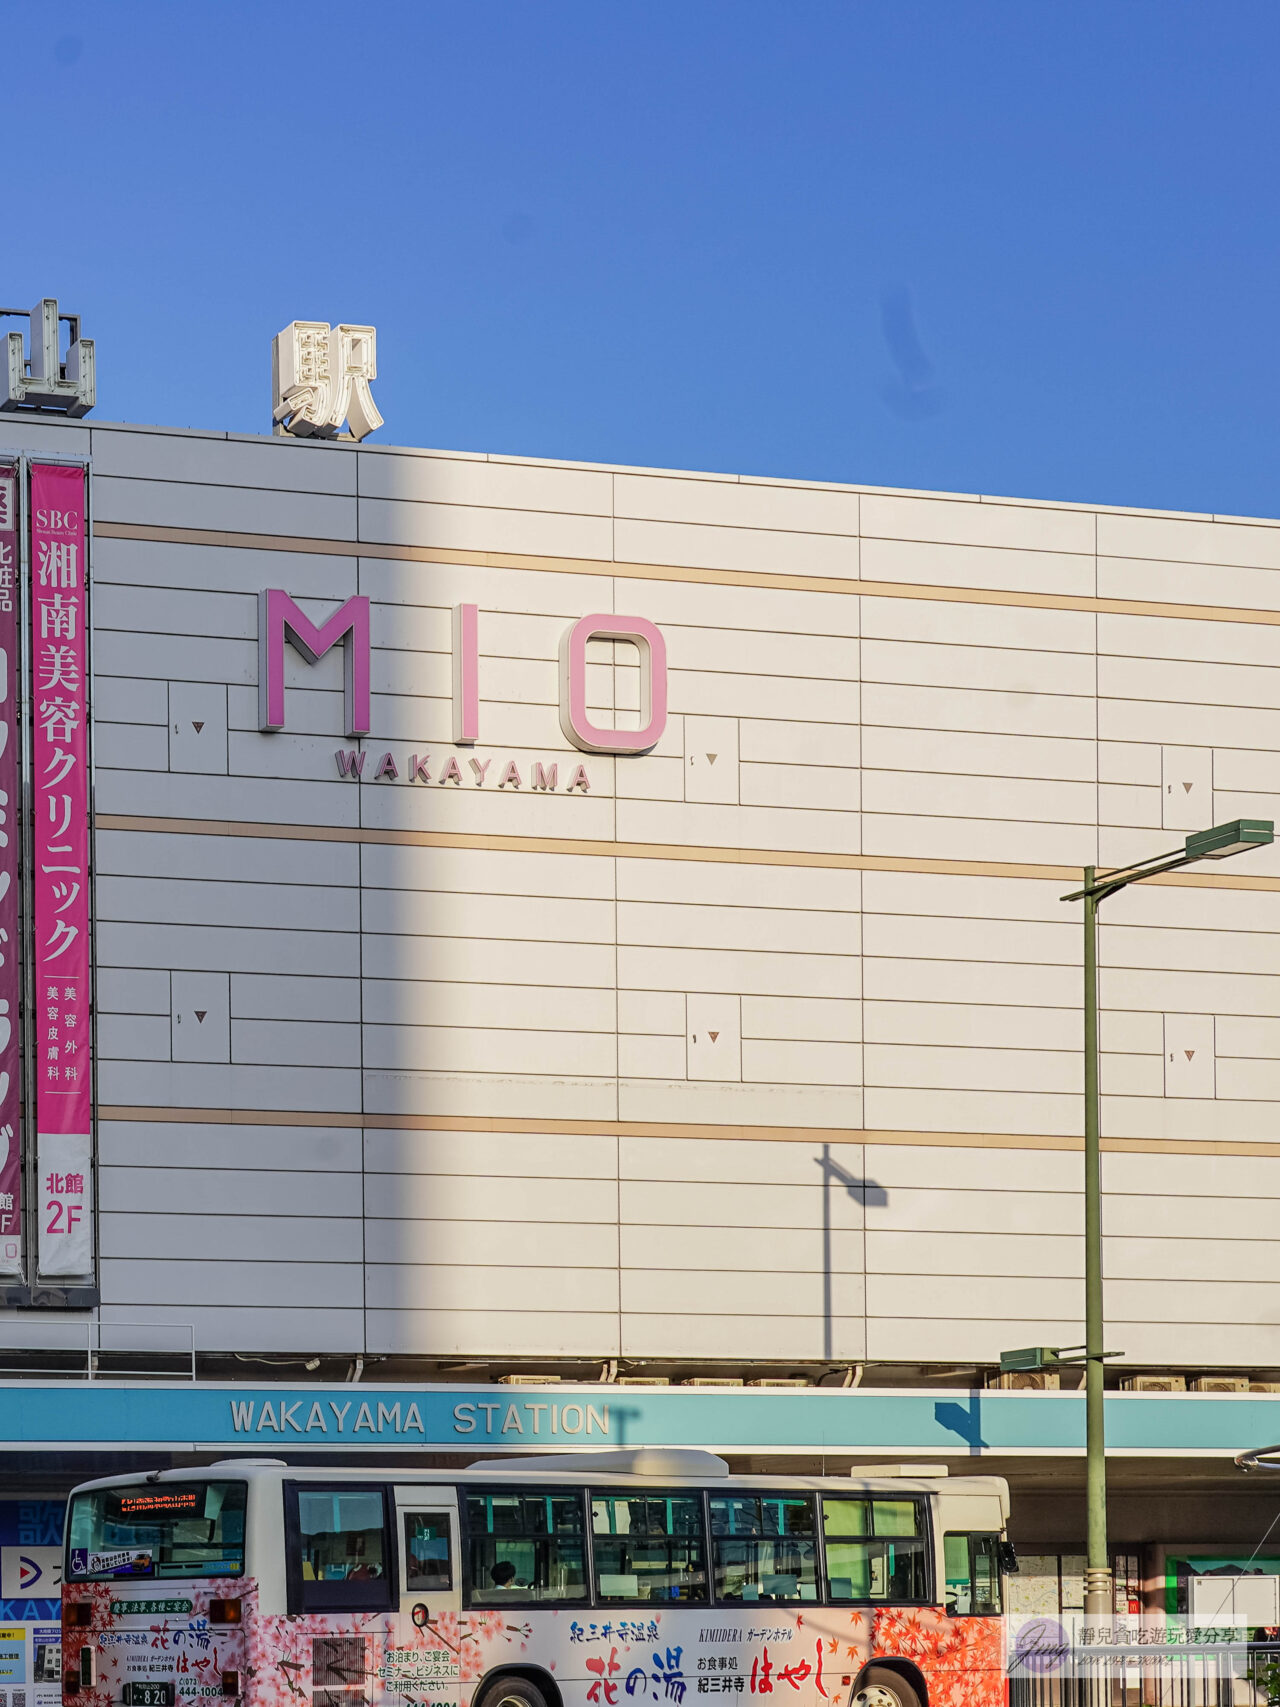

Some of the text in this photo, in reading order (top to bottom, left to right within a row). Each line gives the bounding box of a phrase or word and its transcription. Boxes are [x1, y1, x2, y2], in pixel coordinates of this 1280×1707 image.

[36, 509, 78, 530] SBC
[258, 588, 668, 754] MIO
[37, 540, 80, 962] 湘南美容クリニック
[334, 749, 591, 793] WAKAYAMA
[47, 986, 60, 1081] 美容皮膚科
[64, 986, 78, 1081] 美容外科
[46, 1173, 83, 1195] 北館
[46, 1200, 82, 1235] 2F
[230, 1400, 610, 1435] WAKAYAMA STATION
[150, 1619, 211, 1650] 花の湯
[570, 1620, 660, 1643] 紀三井寺温泉
[699, 1628, 794, 1642] KIMIIDERA ガーデンホテル
[176, 1647, 221, 1676] はやし
[386, 1651, 450, 1662] お泊まり、ご宴会
[697, 1657, 738, 1670] お食事処
[750, 1637, 829, 1698] はやし
[378, 1666, 459, 1678] セミナー、ビジネスに
[386, 1680, 448, 1692] ご利用ください。
[586, 1646, 687, 1705] 花の湯
[698, 1676, 744, 1693] 紀三井寺
